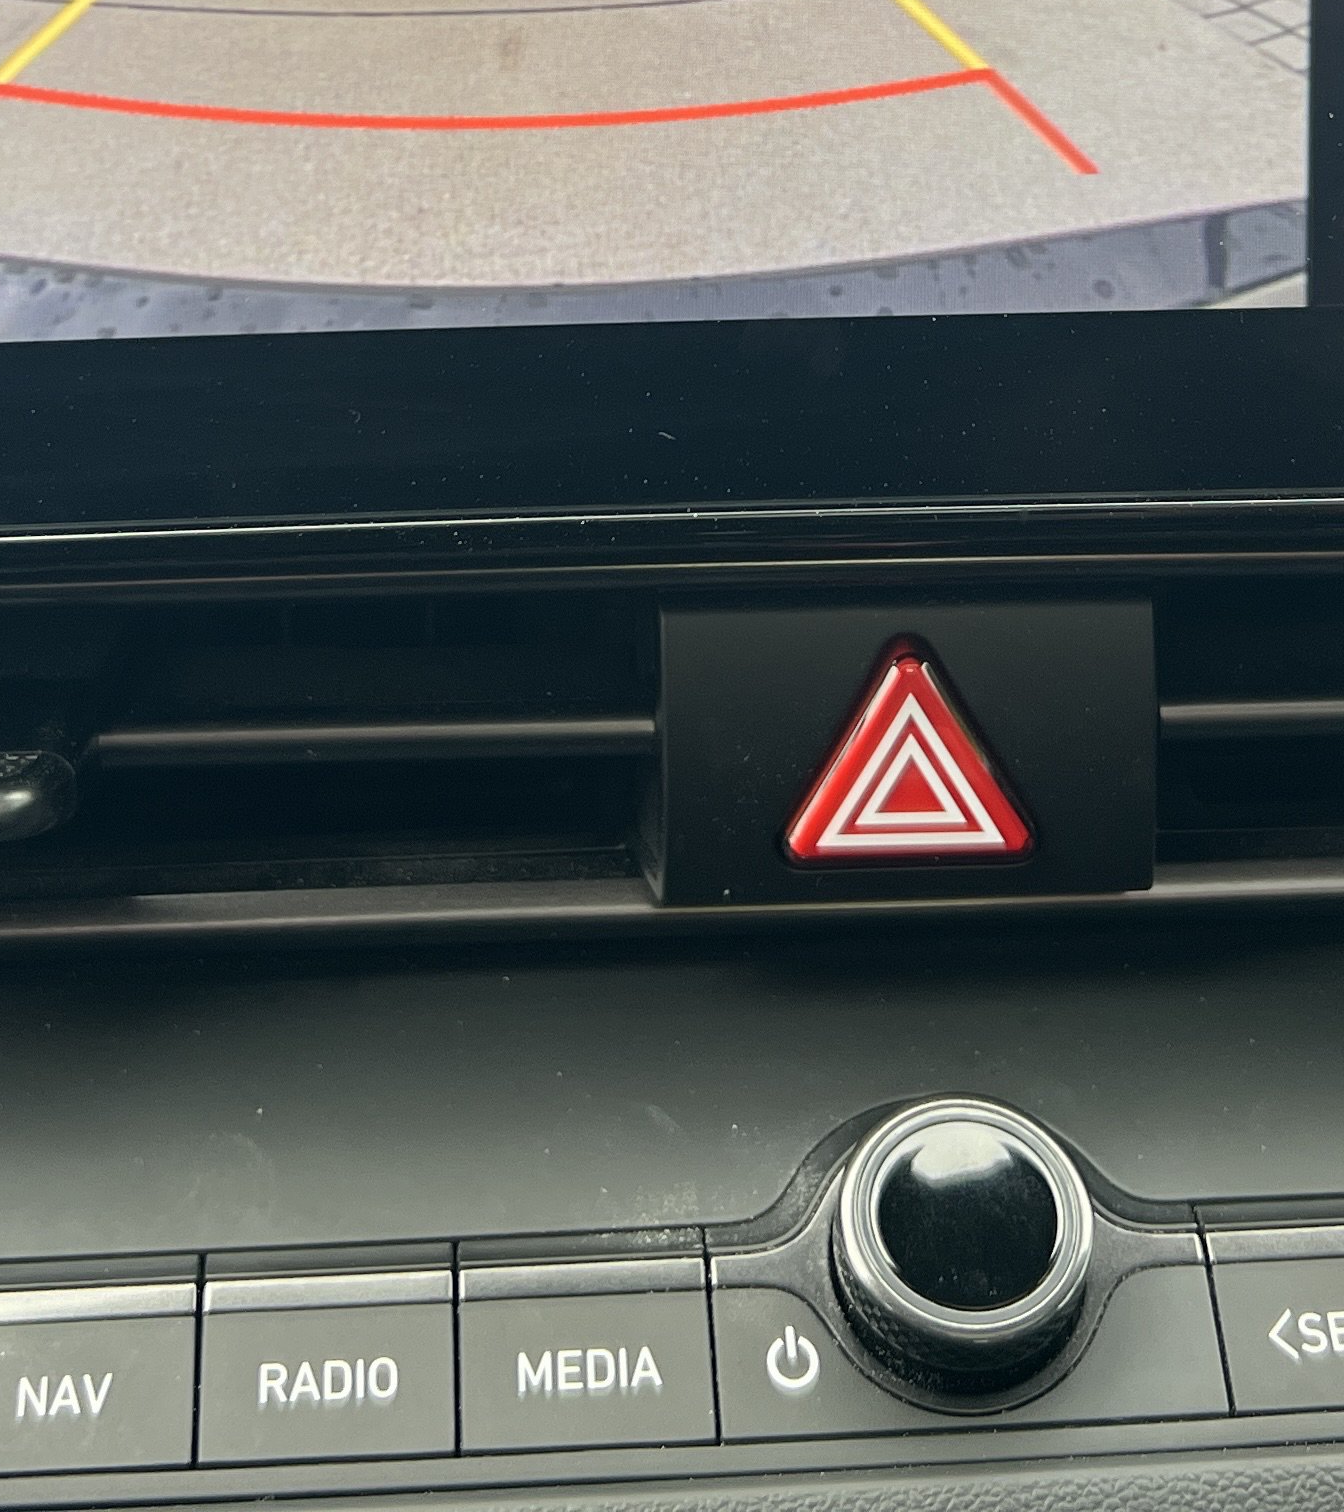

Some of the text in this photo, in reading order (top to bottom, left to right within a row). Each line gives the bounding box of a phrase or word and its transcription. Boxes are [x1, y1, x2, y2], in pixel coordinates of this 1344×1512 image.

[257, 1355, 400, 1405] RADIO
[516, 1345, 664, 1394] MEDIA
[14, 1371, 114, 1418] NAV
